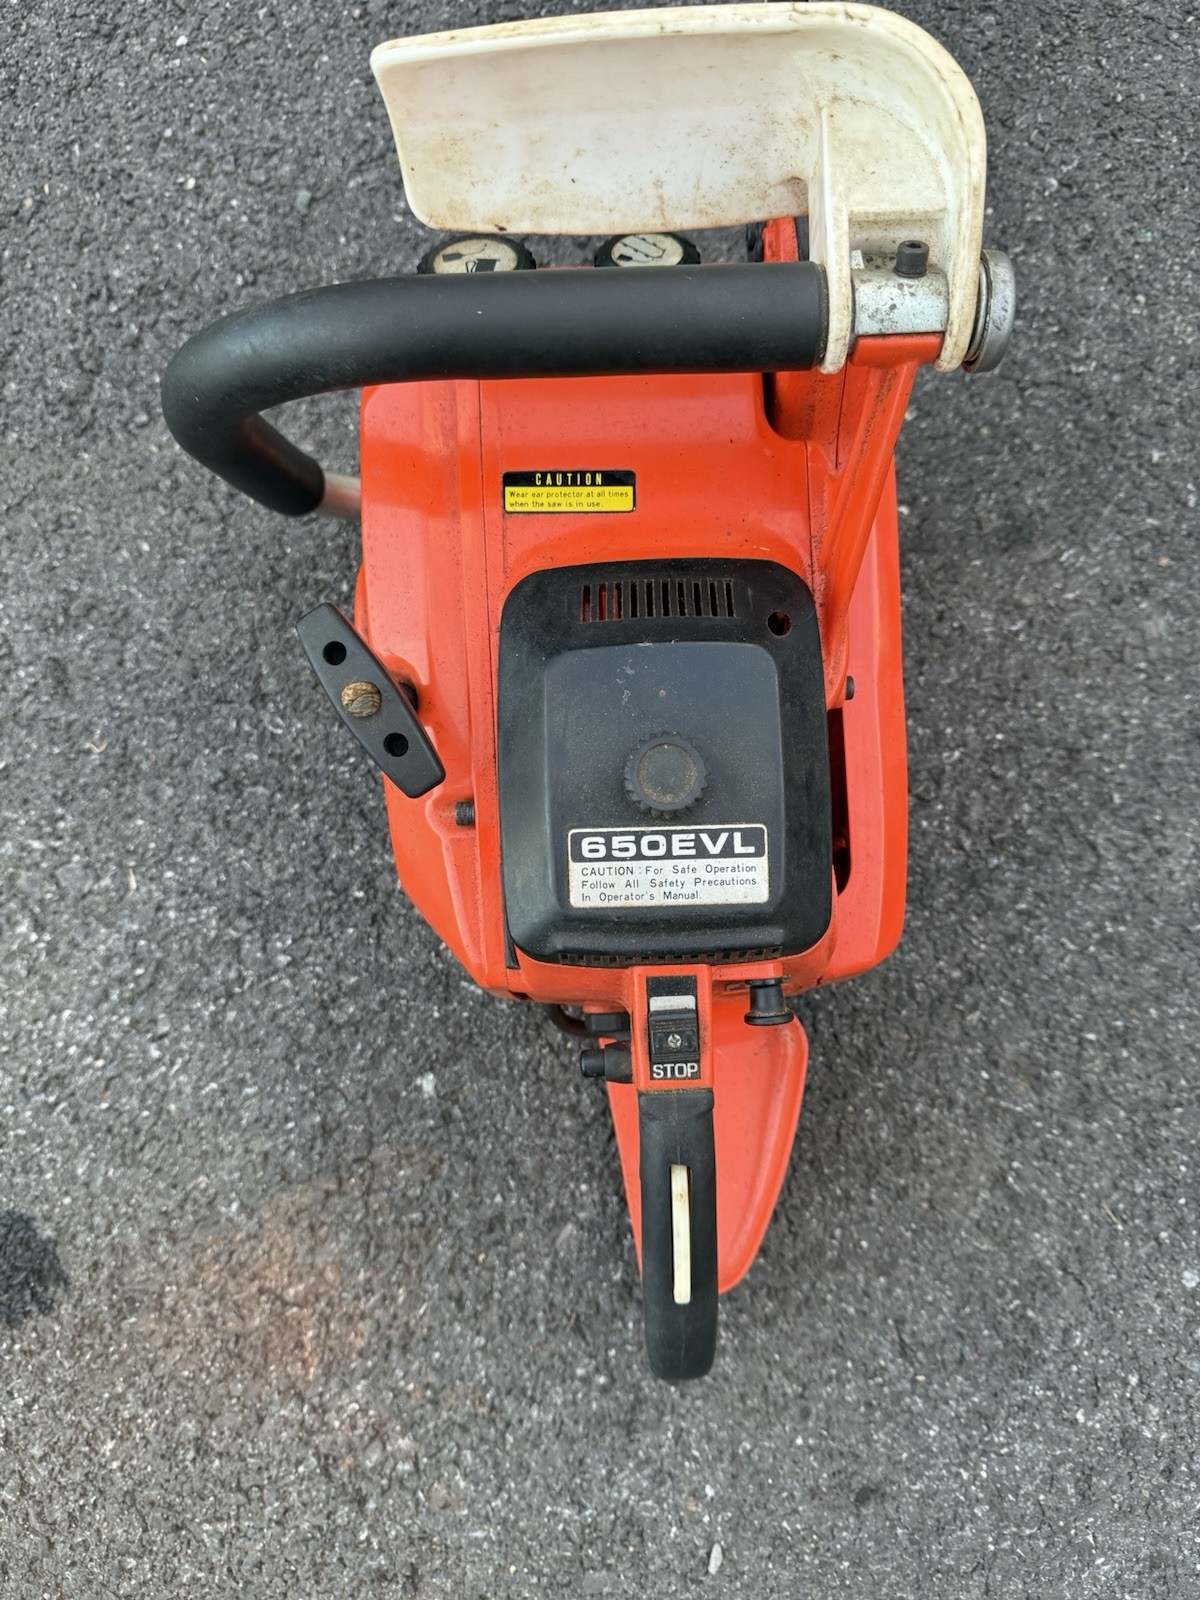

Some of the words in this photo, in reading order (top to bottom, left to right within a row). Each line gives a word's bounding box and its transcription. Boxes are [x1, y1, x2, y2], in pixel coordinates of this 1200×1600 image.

[535, 473, 602, 486] CAUTION
[546, 491, 583, 499] protector
[581, 831, 756, 858] 650EVL
[646, 866, 664, 875] For
[672, 864, 698, 874] Safe
[705, 864, 757, 874] Operation
[582, 880, 616, 890] Follow
[624, 879, 640, 888] All
[650, 878, 686, 889] Safety
[694, 877, 757, 887] Precautions
[582, 892, 591, 902] In
[600, 892, 655, 903] Operator's
[663, 891, 702, 900] Manual.
[652, 1062, 698, 1080] STOP
